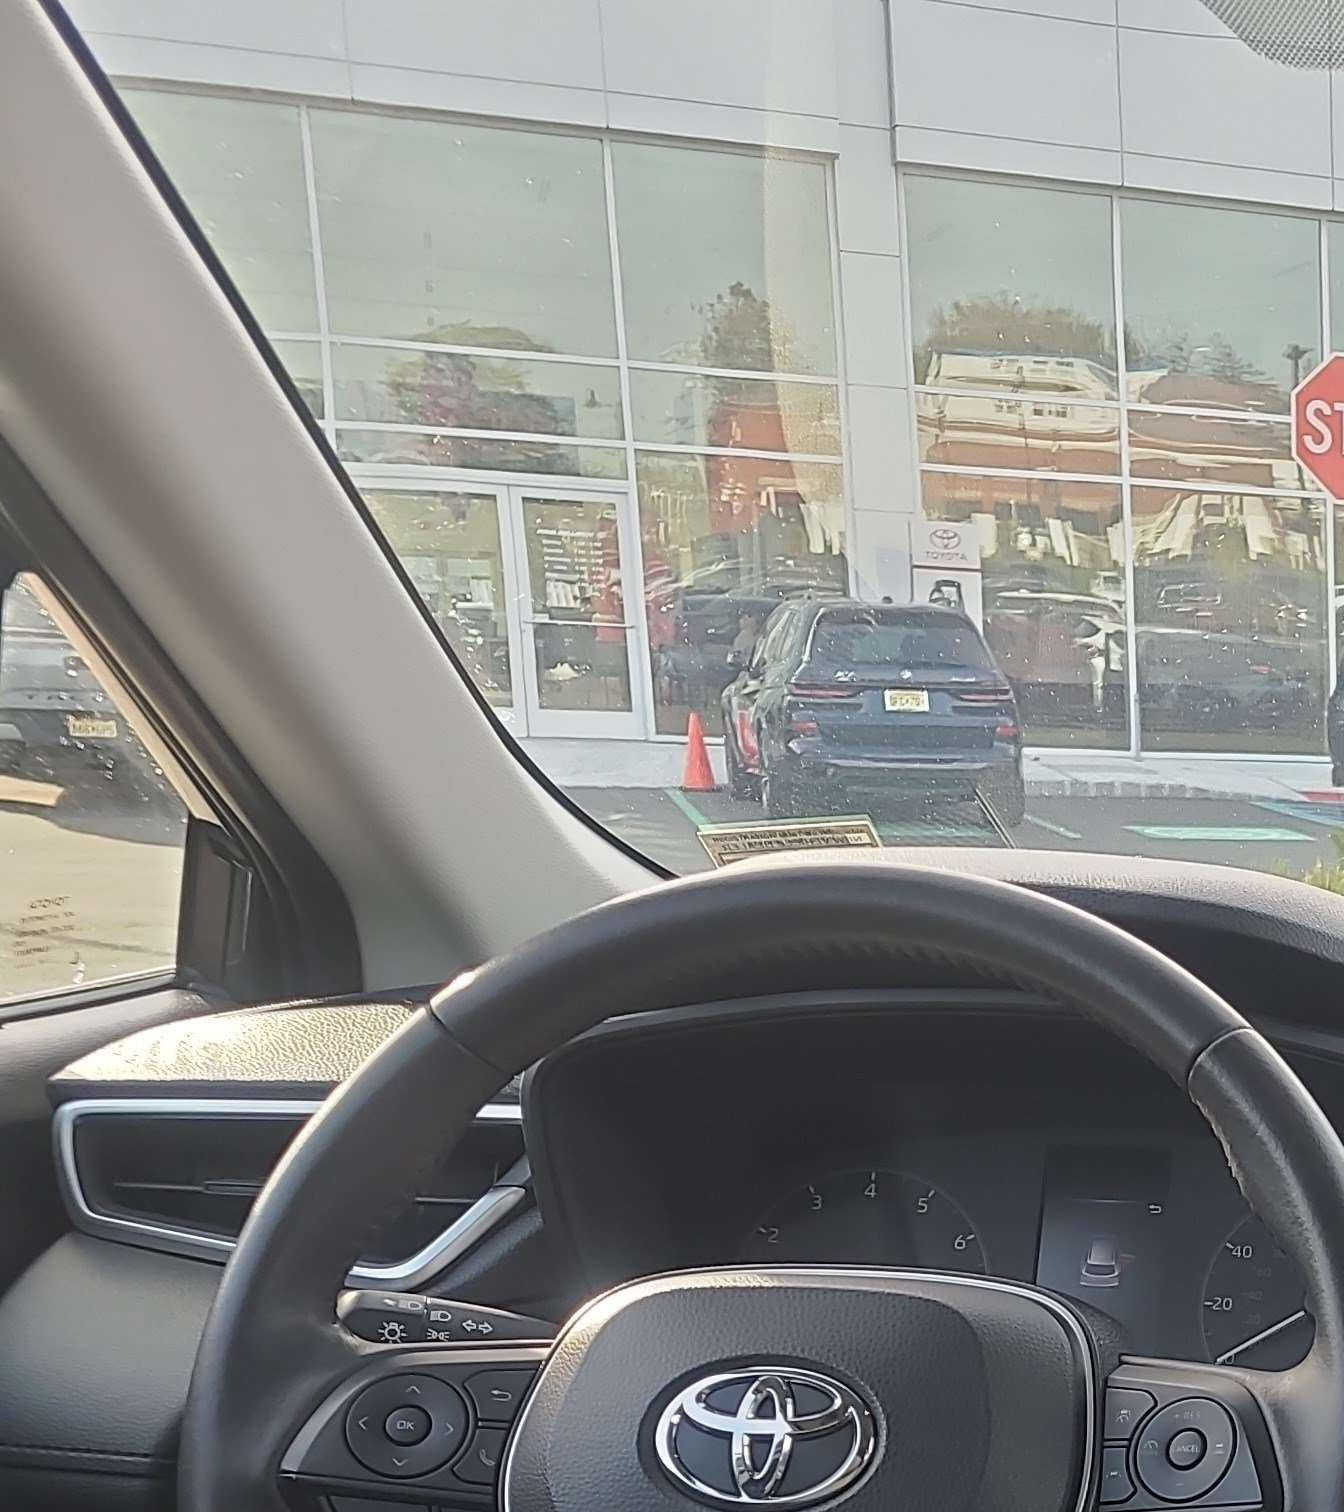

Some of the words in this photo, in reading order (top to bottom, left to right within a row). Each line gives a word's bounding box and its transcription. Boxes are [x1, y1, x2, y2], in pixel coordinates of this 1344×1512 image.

[925, 551, 968, 561] TOYOTA
[864, 1183, 877, 1198] 4
[811, 1195, 823, 1210] 3
[917, 1197, 928, 1213] 5
[767, 1227, 779, 1243] 2
[954, 1234, 966, 1250] 6
[1231, 1245, 1253, 1259] 40
[1212, 1297, 1233, 1311] 20
[396, 1420, 415, 1431] OK
